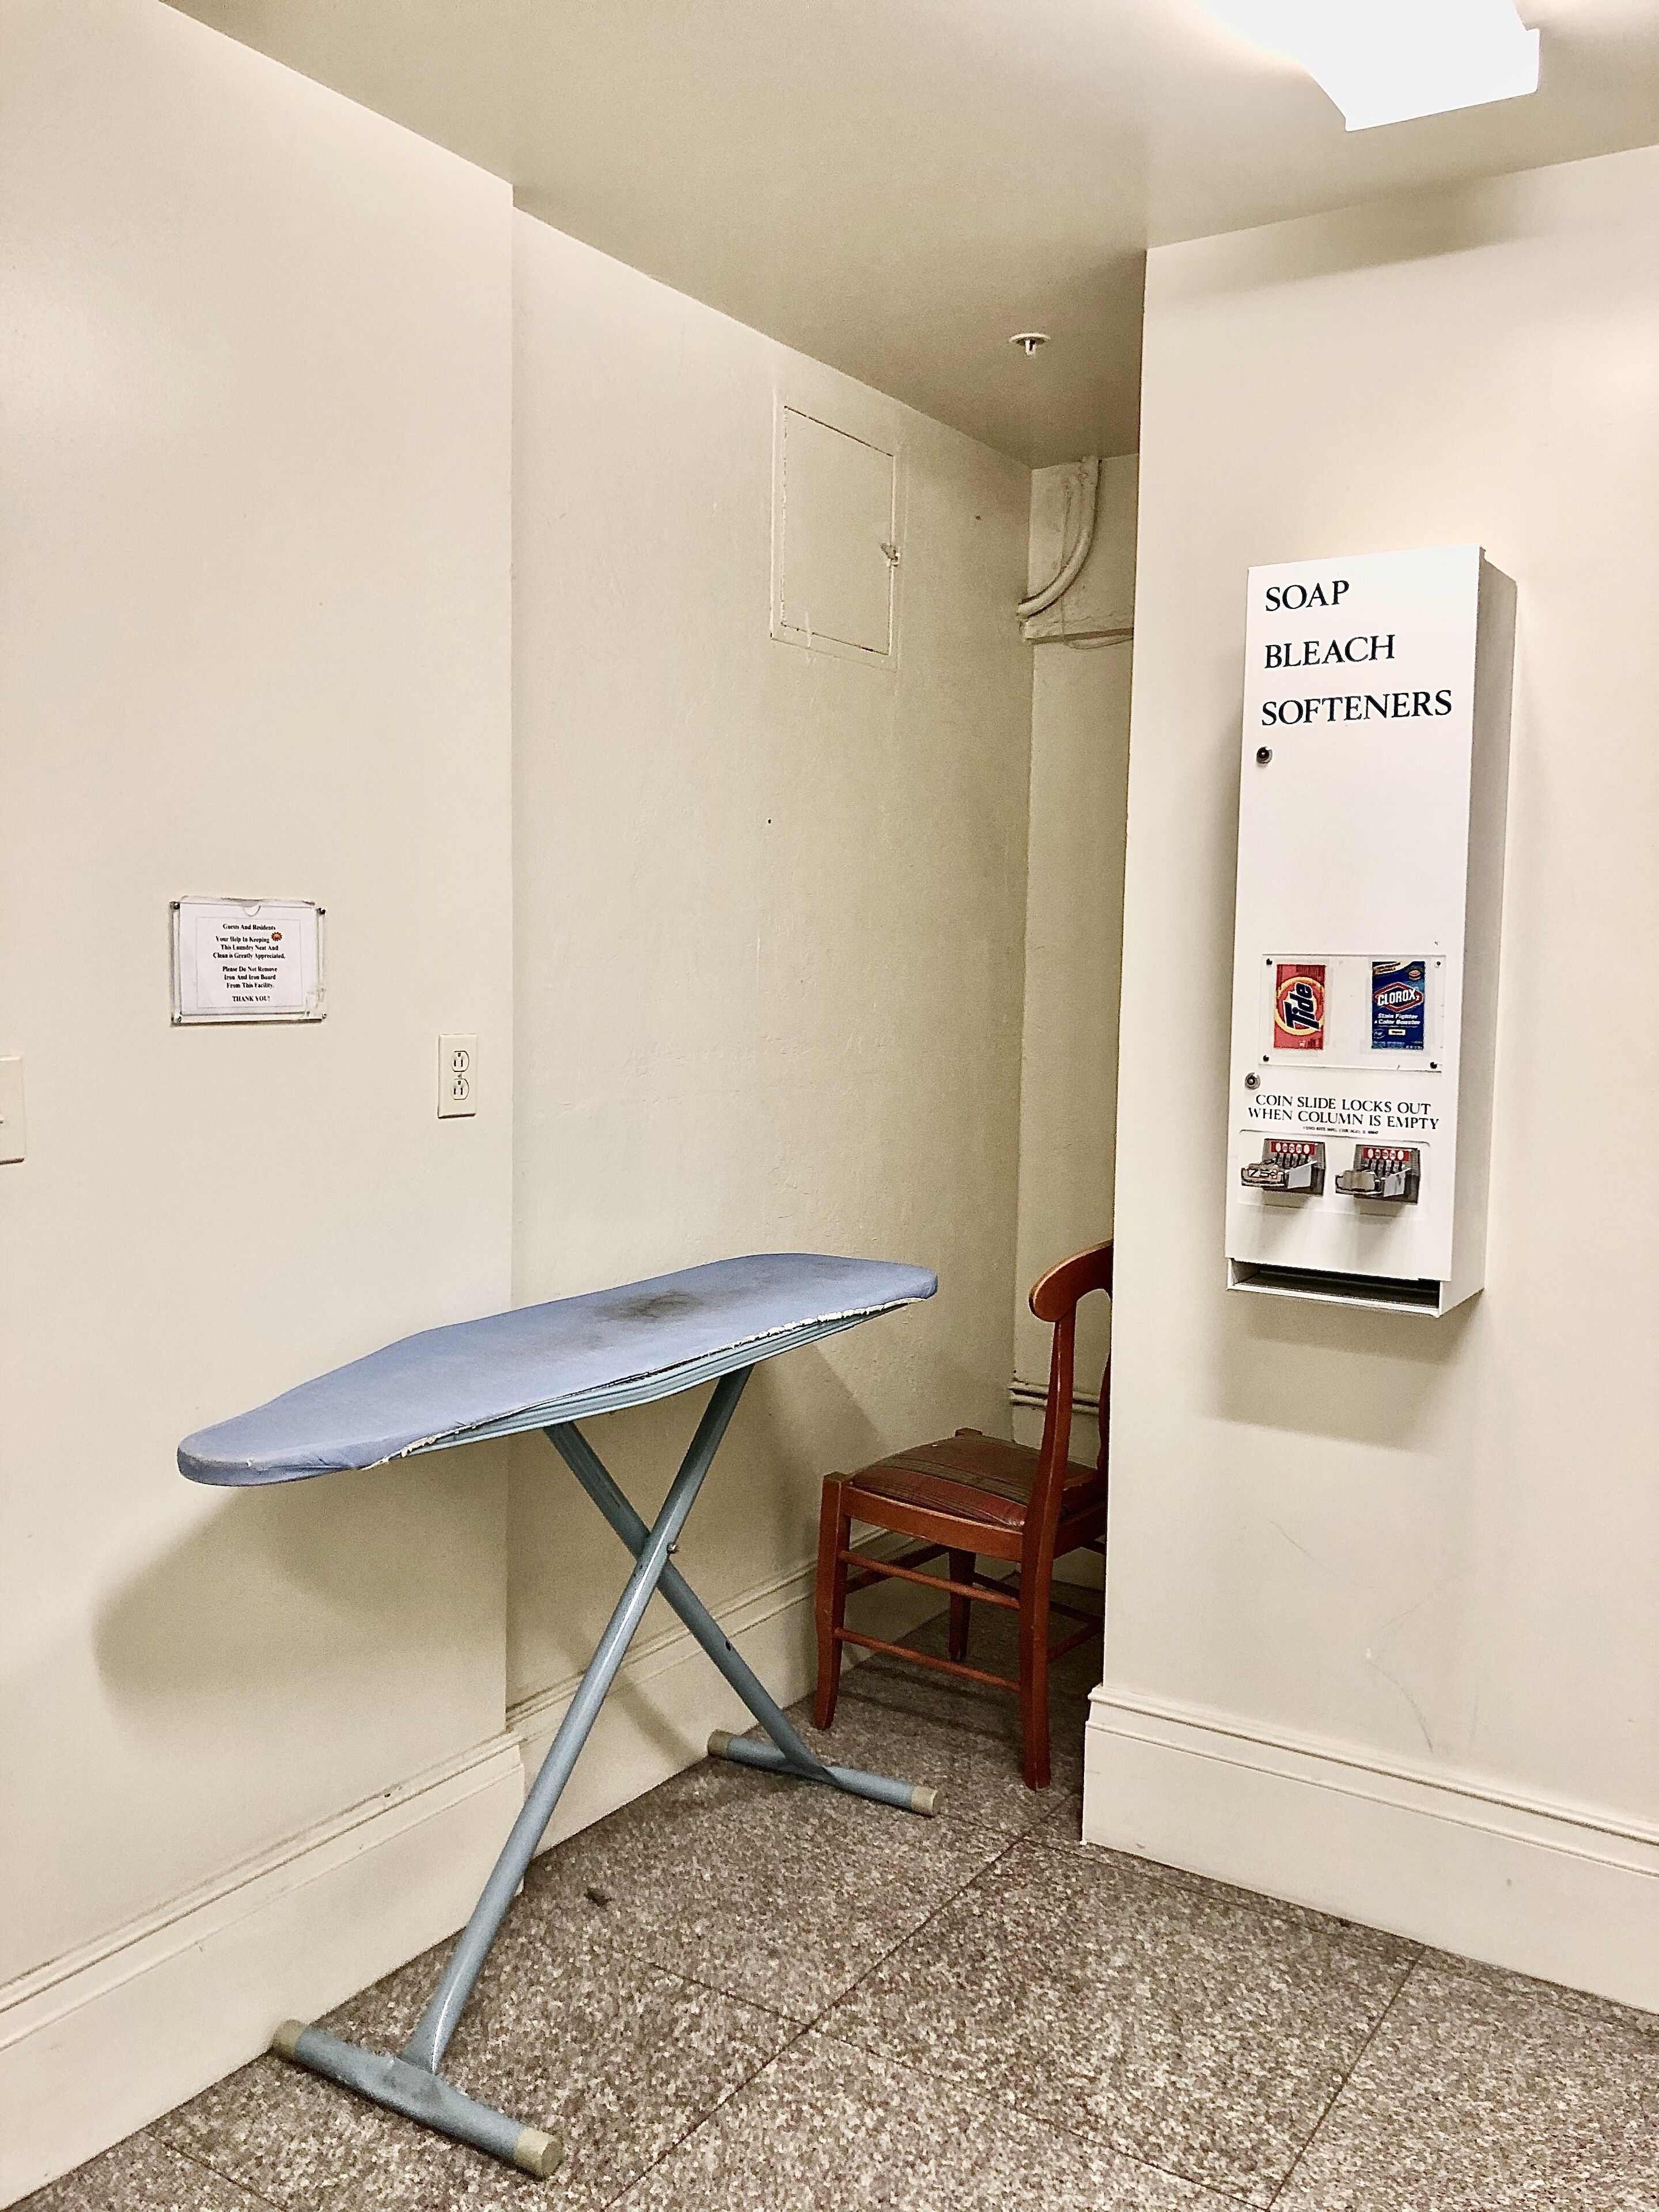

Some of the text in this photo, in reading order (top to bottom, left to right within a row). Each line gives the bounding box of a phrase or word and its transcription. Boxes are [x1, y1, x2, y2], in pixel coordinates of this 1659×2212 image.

[1266, 580, 1349, 611] SOAP
[1264, 634, 1395, 669] BLEACH
[1262, 690, 1452, 726] SOFTENERS
[1284, 983, 1320, 1030] Tide
[1377, 988, 1416, 1006] CLOROX
[1248, 1107, 1440, 1130] WHEN COLUMN IS EMPTY
[1256, 1094, 1431, 1115] COIN SLIDE LOCKS OUT
